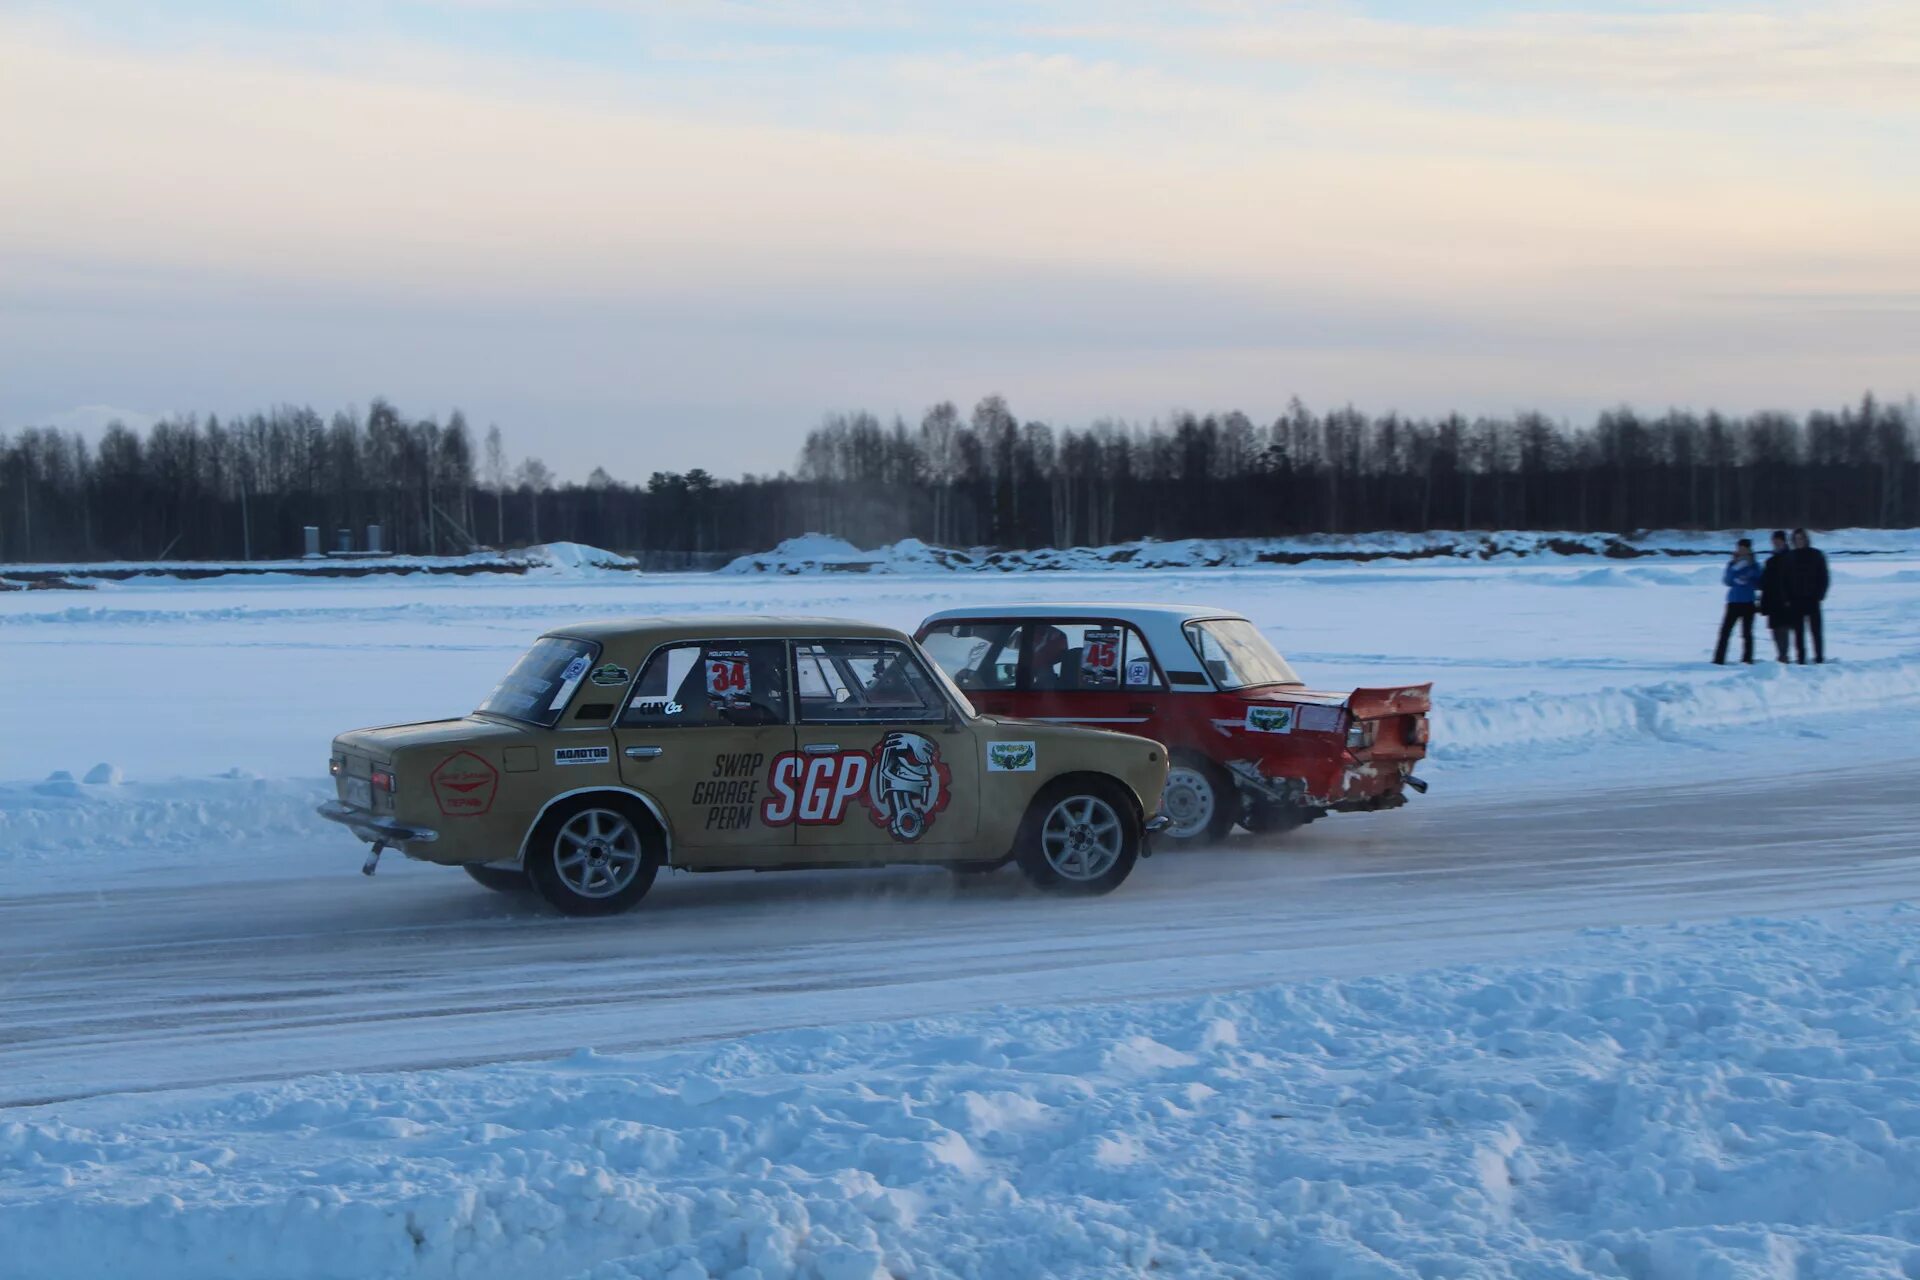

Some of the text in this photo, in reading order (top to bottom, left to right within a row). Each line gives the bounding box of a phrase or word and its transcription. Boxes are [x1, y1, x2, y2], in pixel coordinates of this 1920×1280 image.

[1087, 643, 1116, 668] 45
[712, 663, 746, 691] 34
[713, 753, 764, 777] SWAP
[692, 780, 760, 805] GARAGE
[767, 755, 867, 822] SGP
[705, 806, 753, 830] PERM
